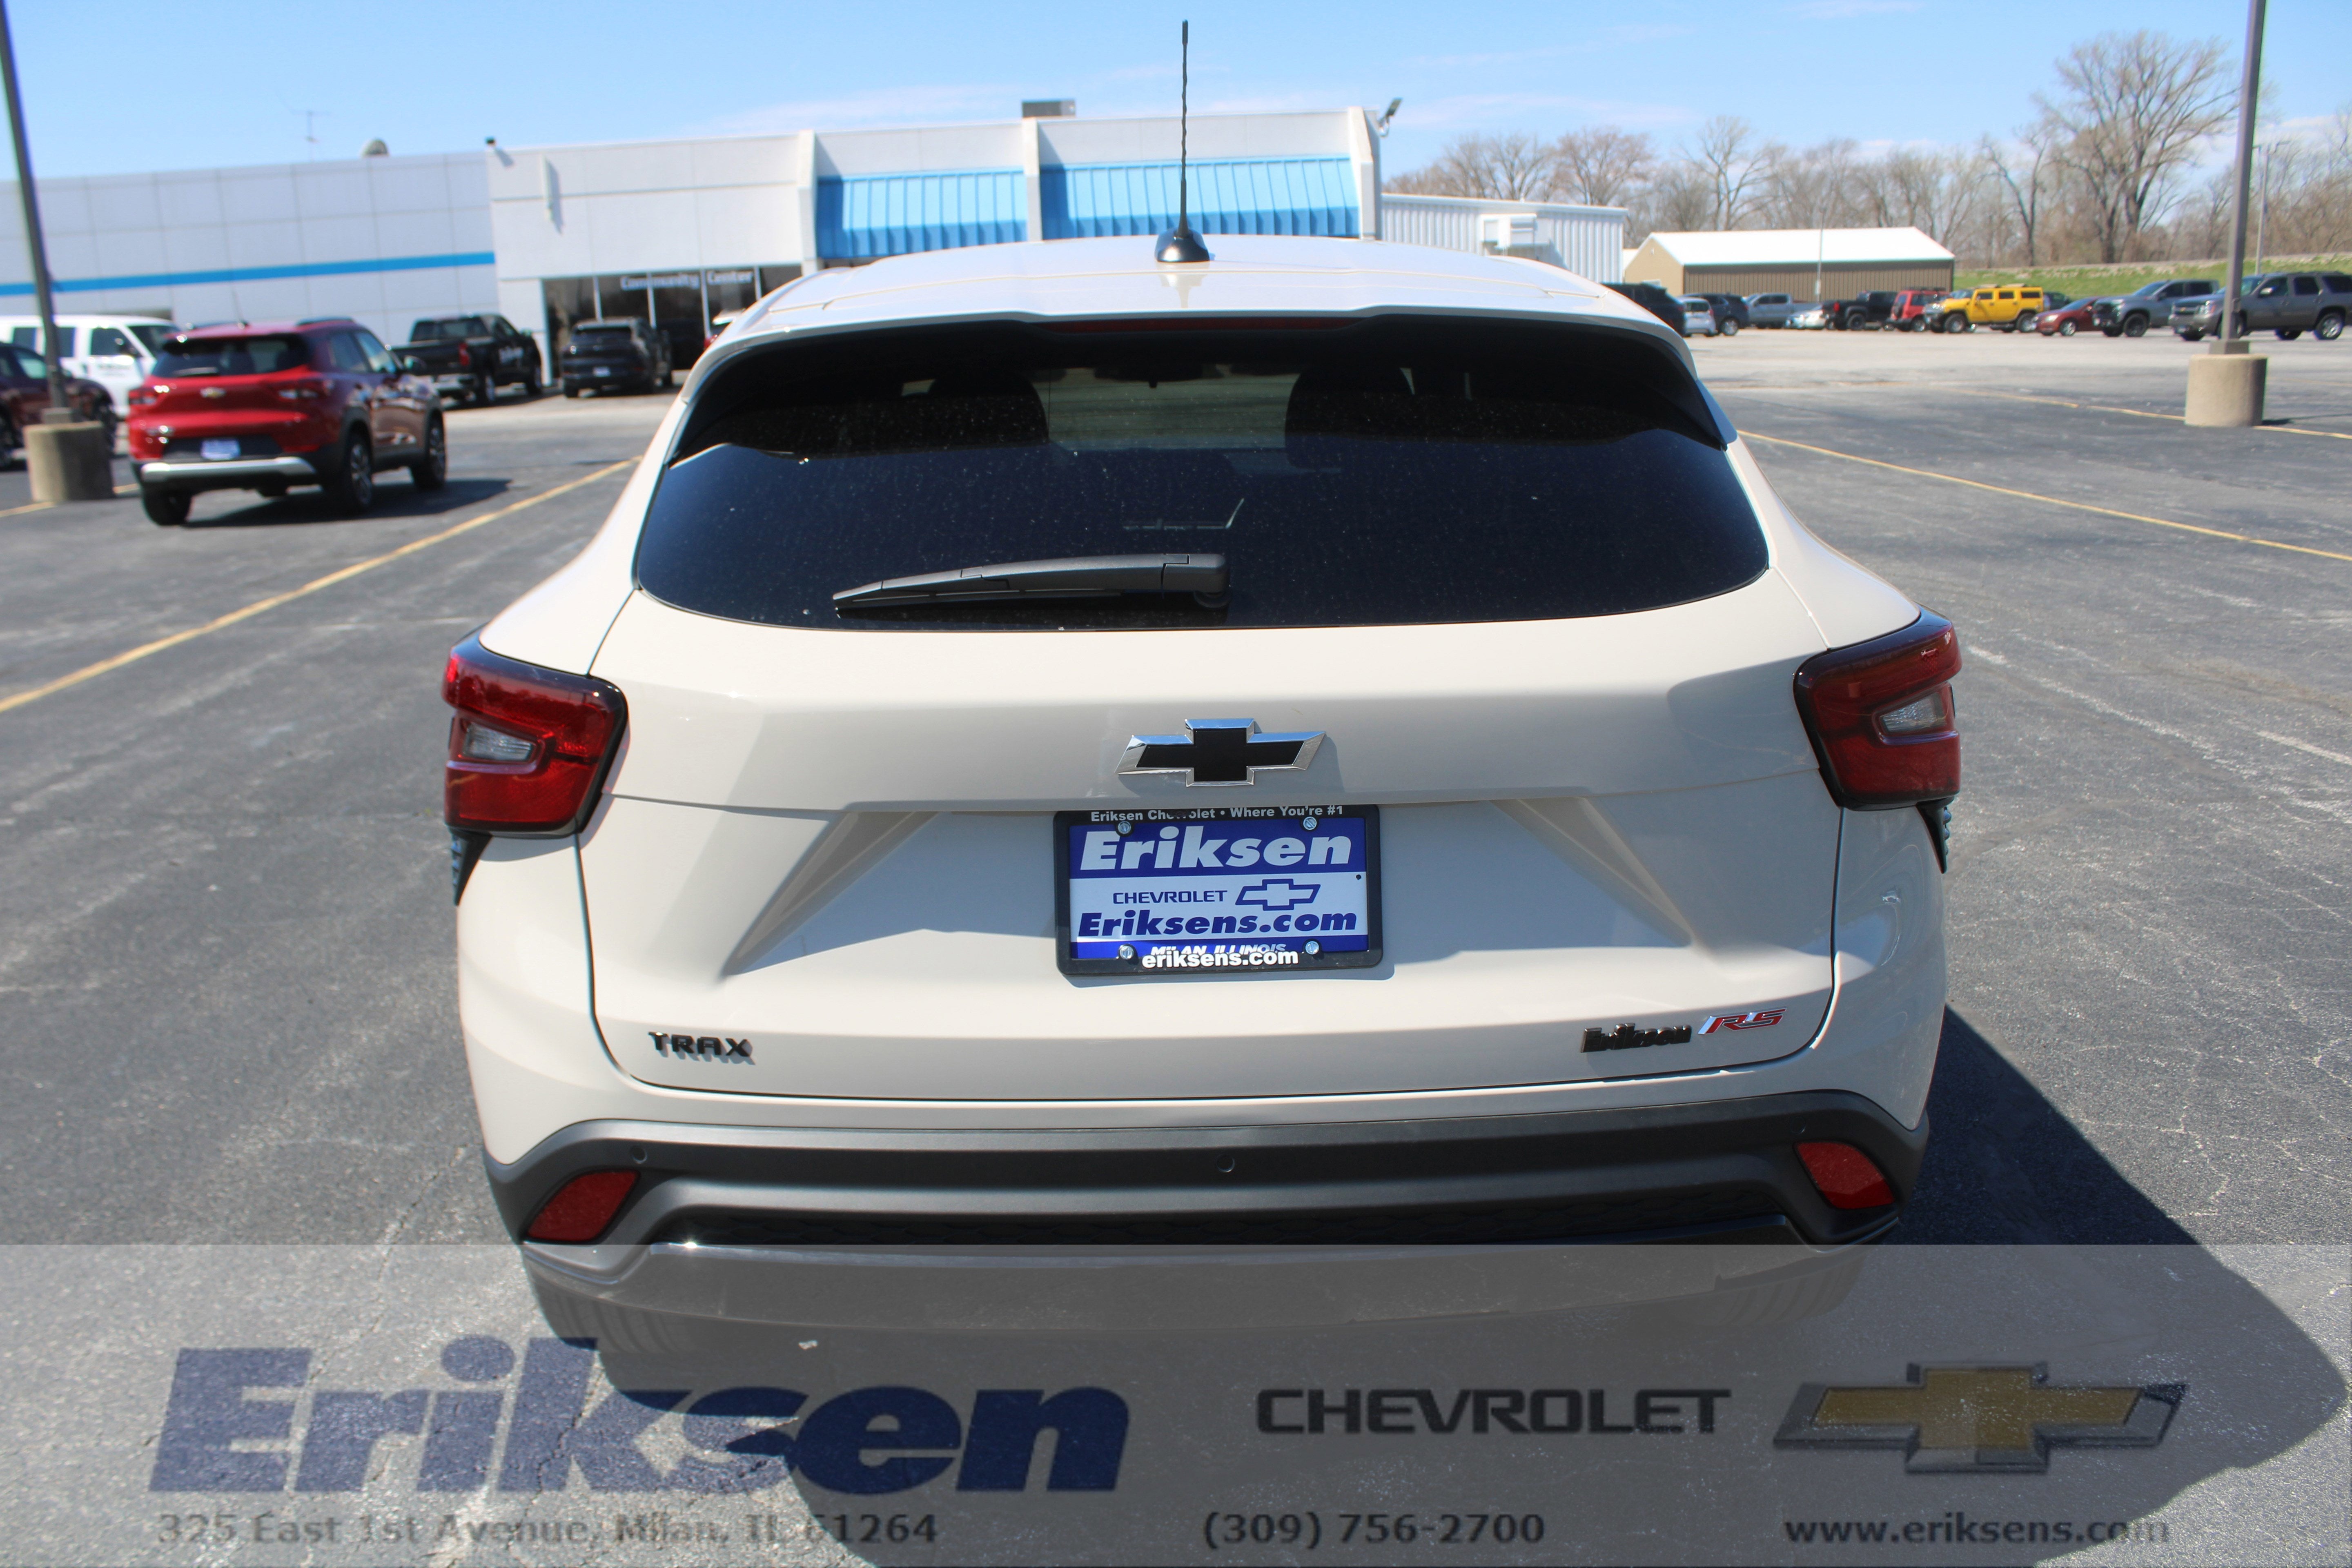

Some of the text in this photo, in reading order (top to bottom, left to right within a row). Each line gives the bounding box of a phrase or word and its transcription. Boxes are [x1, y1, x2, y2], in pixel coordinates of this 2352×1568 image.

[1091, 808, 1215, 822] Eriksen Cheolet
[1230, 805, 1343, 817] Where You're #1
[1080, 826, 1352, 870] Eriksen
[1113, 890, 1228, 904] CHEVROLET
[1078, 909, 1357, 937] Eriksens.com
[1142, 950, 1299, 969] eriksens.com
[1697, 1008, 1787, 1035] RS
[648, 1031, 750, 1057] TRAX
